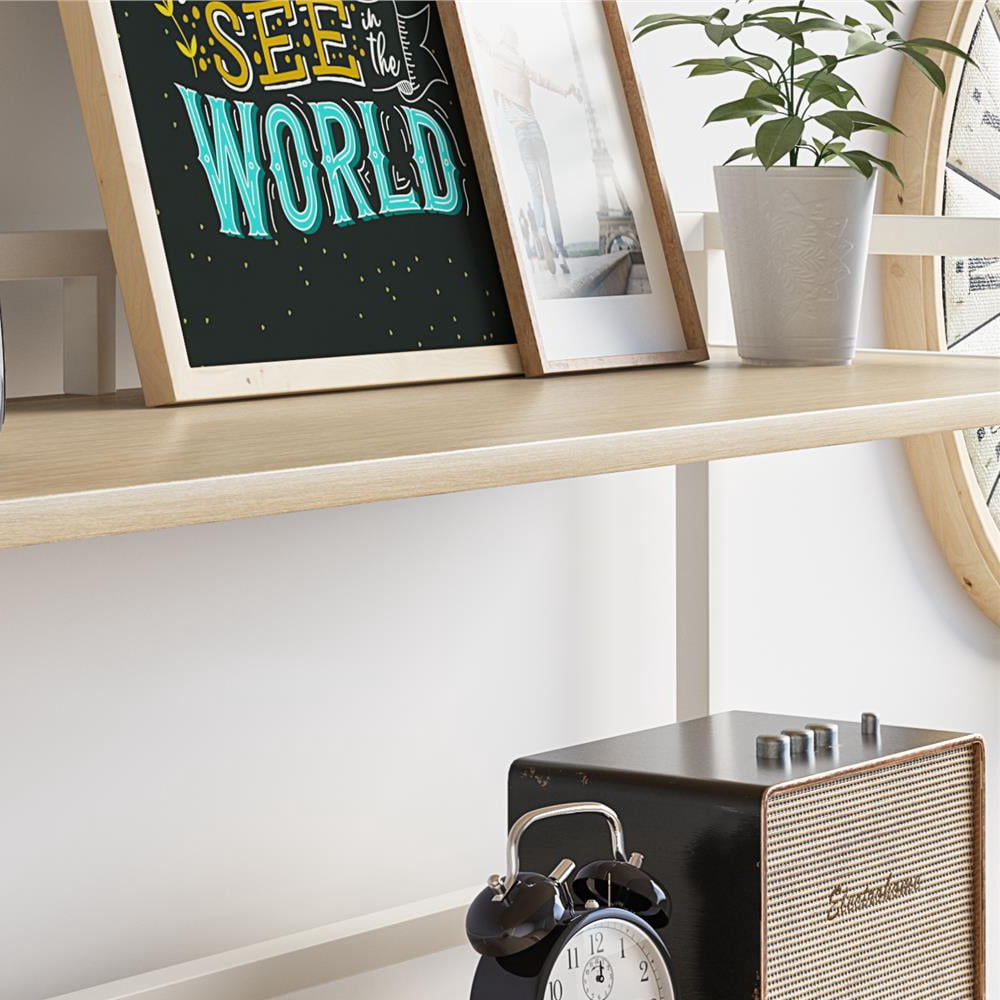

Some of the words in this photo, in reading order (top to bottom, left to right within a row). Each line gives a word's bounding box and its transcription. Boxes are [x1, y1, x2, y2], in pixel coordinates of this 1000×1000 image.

[361, 8, 382, 30] in
[205, 0, 366, 91] SEE
[366, 34, 401, 77] the
[174, 82, 463, 240] WORLD
[589, 931, 605, 955] 12
[619, 937, 626, 959] 1
[567, 947, 580, 970] 11
[639, 960, 649, 982] 2
